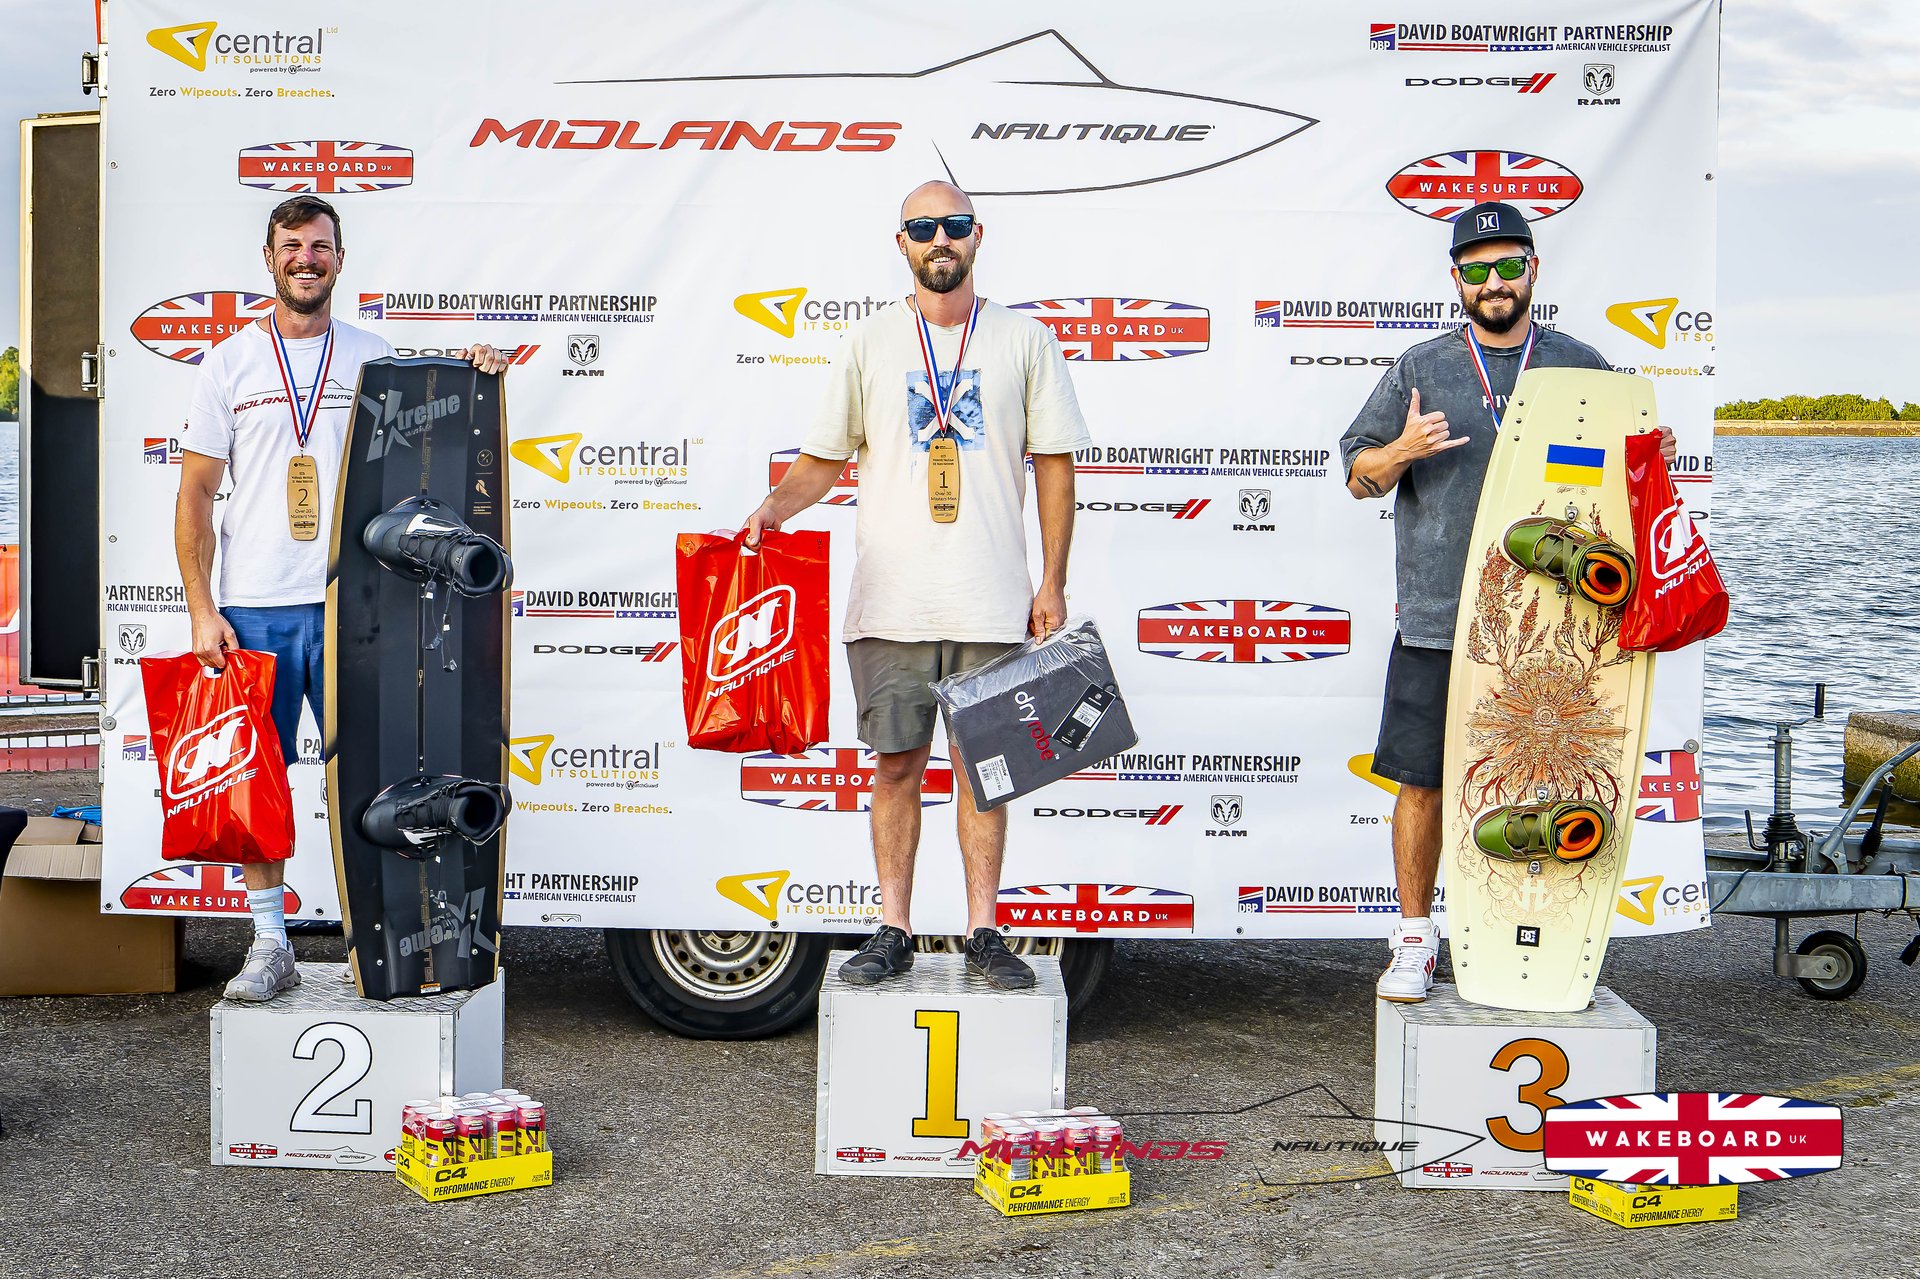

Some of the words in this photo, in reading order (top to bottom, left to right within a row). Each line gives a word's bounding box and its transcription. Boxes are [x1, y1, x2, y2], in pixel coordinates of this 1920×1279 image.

[1399, 24, 1447, 41] DAVID
[1451, 25, 1557, 42] BOATWRIGHT
[1564, 25, 1673, 42] PARTNERSHIP
[215, 28, 323, 54] central
[1371, 41, 1390, 50] DBP
[1555, 43, 1596, 51] AMERICAN
[1597, 43, 1627, 52] VEHICLE
[1629, 43, 1671, 52] SPECIALIST
[215, 55, 227, 64] IT
[230, 55, 322, 64] SOLUTIONS
[279, 66, 287, 74] by
[1405, 77, 1534, 87] DODGE
[150, 87, 176, 97] Zero
[180, 87, 241, 99] Wipeouts.
[245, 88, 273, 97] Zero
[277, 87, 335, 98] Breaches.
[469, 118, 902, 152] MIDLANDS
[971, 122, 1215, 143] NAUTIQUE
[263, 161, 378, 173] WAKEBOARD
[1419, 182, 1531, 193] WAKESURF
[1538, 182, 1559, 193] UK
[386, 294, 433, 310] DAVID
[438, 294, 543, 311] BOATWRIGHT
[549, 295, 657, 312] PARTNERSHIP
[804, 296, 900, 321] centr
[1283, 301, 1331, 317] DAVID
[1337, 301, 1444, 318] BOATWRIGHT
[360, 310, 379, 319] DBP
[540, 314, 580, 322] AMERICAN
[582, 314, 611, 323] VEHICLE
[613, 314, 654, 323] SPECIALIST
[804, 322, 817, 330] IT
[1255, 317, 1276, 327] DBP
[161, 324, 238, 334] WAKESU
[1051, 323, 1166, 336] AKEBOARD
[1675, 333, 1688, 341] IT
[737, 354, 764, 364] Zero
[769, 355, 830, 366] Wipeouts.
[1291, 356, 1398, 366] DODG
[1640, 366, 1702, 377] Wipeouts.
[144, 454, 162, 464] DBP
[579, 439, 688, 466] central
[1073, 448, 1102, 463] VID
[1107, 447, 1213, 465] BOATWRIGHT
[1220, 449, 1329, 467] PARTNERSHIP
[578, 467, 591, 476] IT
[594, 468, 688, 476] SOLUTIONS
[1211, 468, 1250, 477] AMERICAN
[1252, 468, 1283, 477] VEHICLE
[1285, 468, 1327, 477] SPECIALIST
[614, 478, 644, 486] powered
[645, 478, 653, 486] by
[940, 470, 948, 488] 1
[298, 489, 308, 506] 2
[513, 499, 541, 510] Zero
[544, 499, 606, 512] Wipeouts.
[610, 500, 638, 510] Zero
[643, 500, 701, 511] Breaches.
[106, 585, 184, 602] ARTNERSH
[526, 591, 573, 606] DAVID
[578, 591, 678, 607] BOATWRIGHT
[107, 603, 129, 612] RICAN
[130, 604, 157, 612] VEHICLE
[159, 604, 189, 613] SPECIAL
[1168, 625, 1307, 638] WAKEBOARD
[534, 645, 655, 655] DODGE
[706, 649, 796, 700] NAUTIQUE
[1014, 691, 1054, 762] dryrobe
[123, 751, 141, 760] DBP
[551, 743, 659, 769] central
[1095, 755, 1185, 772] ATWRIGHT
[1192, 755, 1301, 772] PARTNERSHIP
[550, 770, 563, 778] IT
[567, 770, 659, 779] SOLUTIONS
[771, 773, 876, 786] WAKEBOA
[1183, 774, 1221, 783] AMERICAN
[1222, 774, 1254, 783] VEHICLE
[1256, 774, 1298, 783] SPECIALIST
[586, 781, 615, 790] powered
[617, 781, 624, 790] by
[1640, 781, 1699, 792] AKESU
[167, 768, 258, 818] NAUTIQUE
[516, 801, 577, 813] Wipeouts.
[582, 802, 610, 813] Zero
[614, 803, 672, 814] Breaches.
[1034, 807, 1160, 818] DODGE
[1350, 815, 1378, 825] Zero
[531, 874, 639, 891] PARTNERSHIP
[522, 892, 562, 902] AMERICAN
[563, 893, 593, 902] VEHICLE
[595, 893, 637, 903] SPECIALIST
[787, 880, 882, 905] centra
[1266, 887, 1314, 903] DAVID
[1319, 887, 1399, 904] BOATWRI
[787, 905, 800, 914] IT
[806, 905, 883, 915] SOLUTION
[1239, 902, 1258, 912] DBP
[1010, 909, 1150, 922] WAKEBOARD
[290, 1021, 372, 1135] 2
[912, 1009, 970, 1138] 1
[1486, 1037, 1570, 1152] 3
[435, 1167, 468, 1182] C4
[434, 1180, 488, 1196] PERFORMANCE
[490, 1177, 515, 1188] ENERGY
[1010, 1185, 1042, 1198] C4
[1008, 1199, 1063, 1212] PERFORMANCE
[1065, 1197, 1090, 1207] ENERGY
[1632, 1195, 1662, 1209] C4
[1630, 1210, 1680, 1222] PERFORMANCE
[1681, 1208, 1704, 1218] ENERGY
